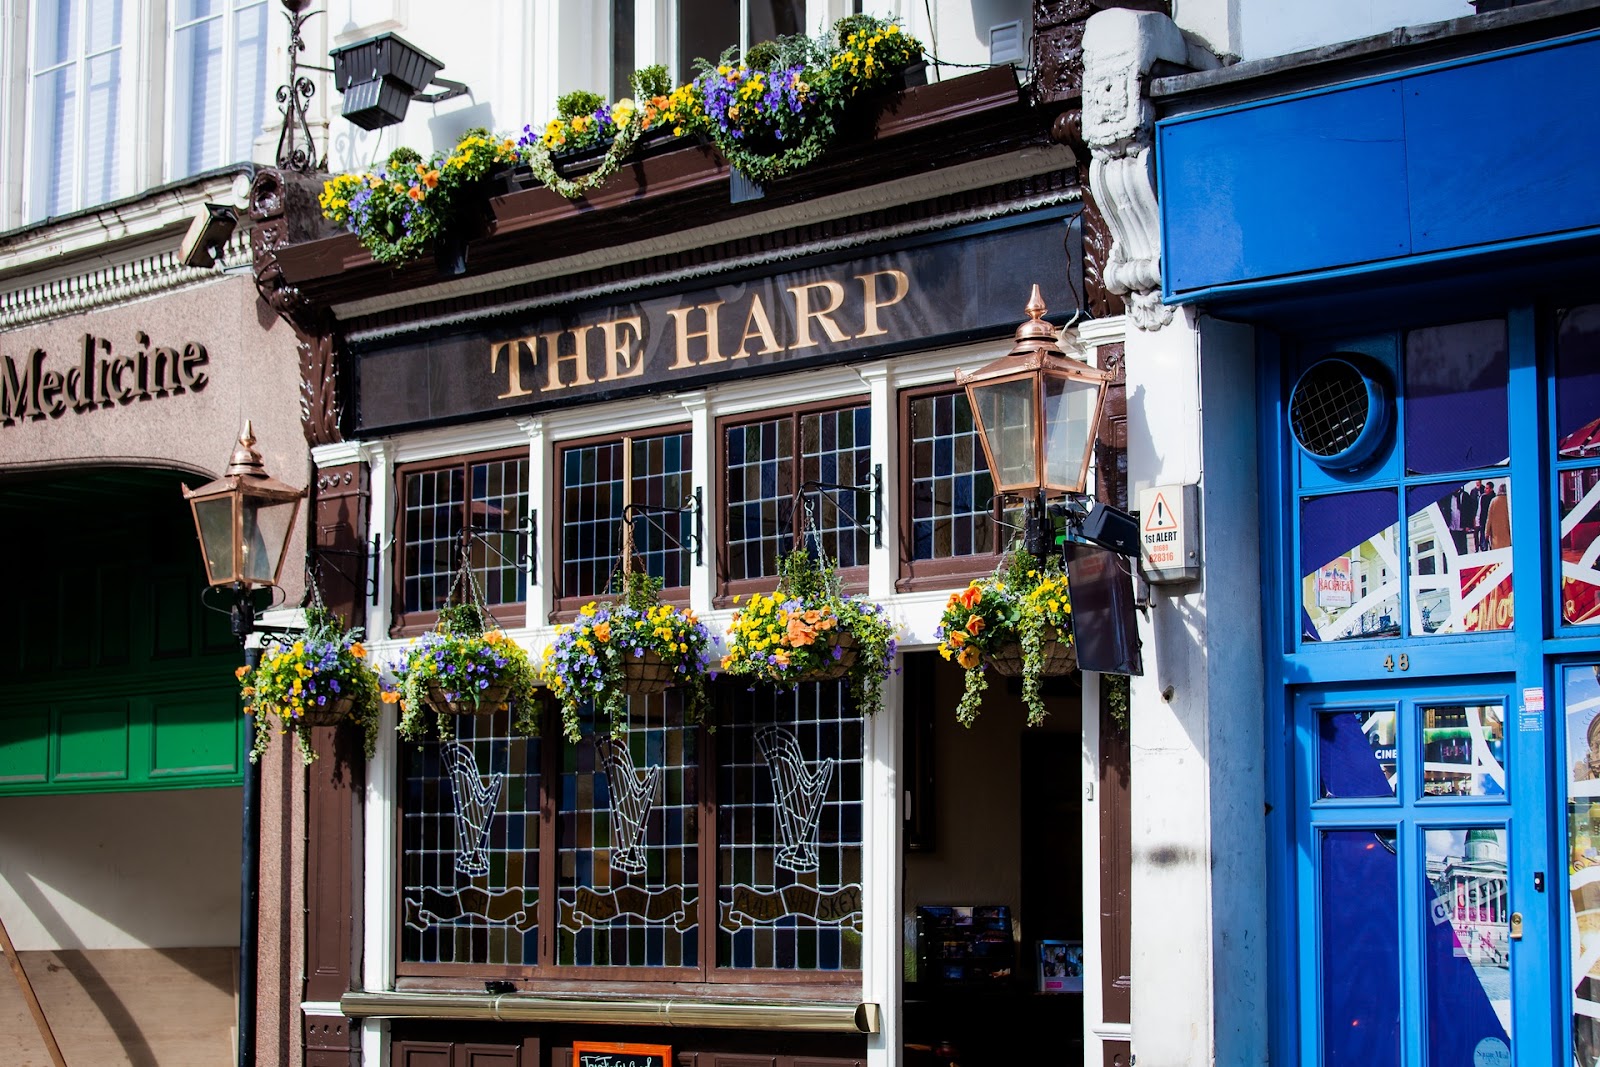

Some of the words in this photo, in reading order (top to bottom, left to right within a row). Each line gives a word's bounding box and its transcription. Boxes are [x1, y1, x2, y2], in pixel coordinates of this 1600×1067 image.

[490, 316, 645, 400] THE
[666, 269, 910, 371] HARP
[0, 331, 208, 426] Medicine
[1145, 534, 1155, 543] 1st
[1156, 531, 1177, 542] ALERT
[1383, 653, 1410, 673] 48
[1374, 749, 1397, 760] CINE
